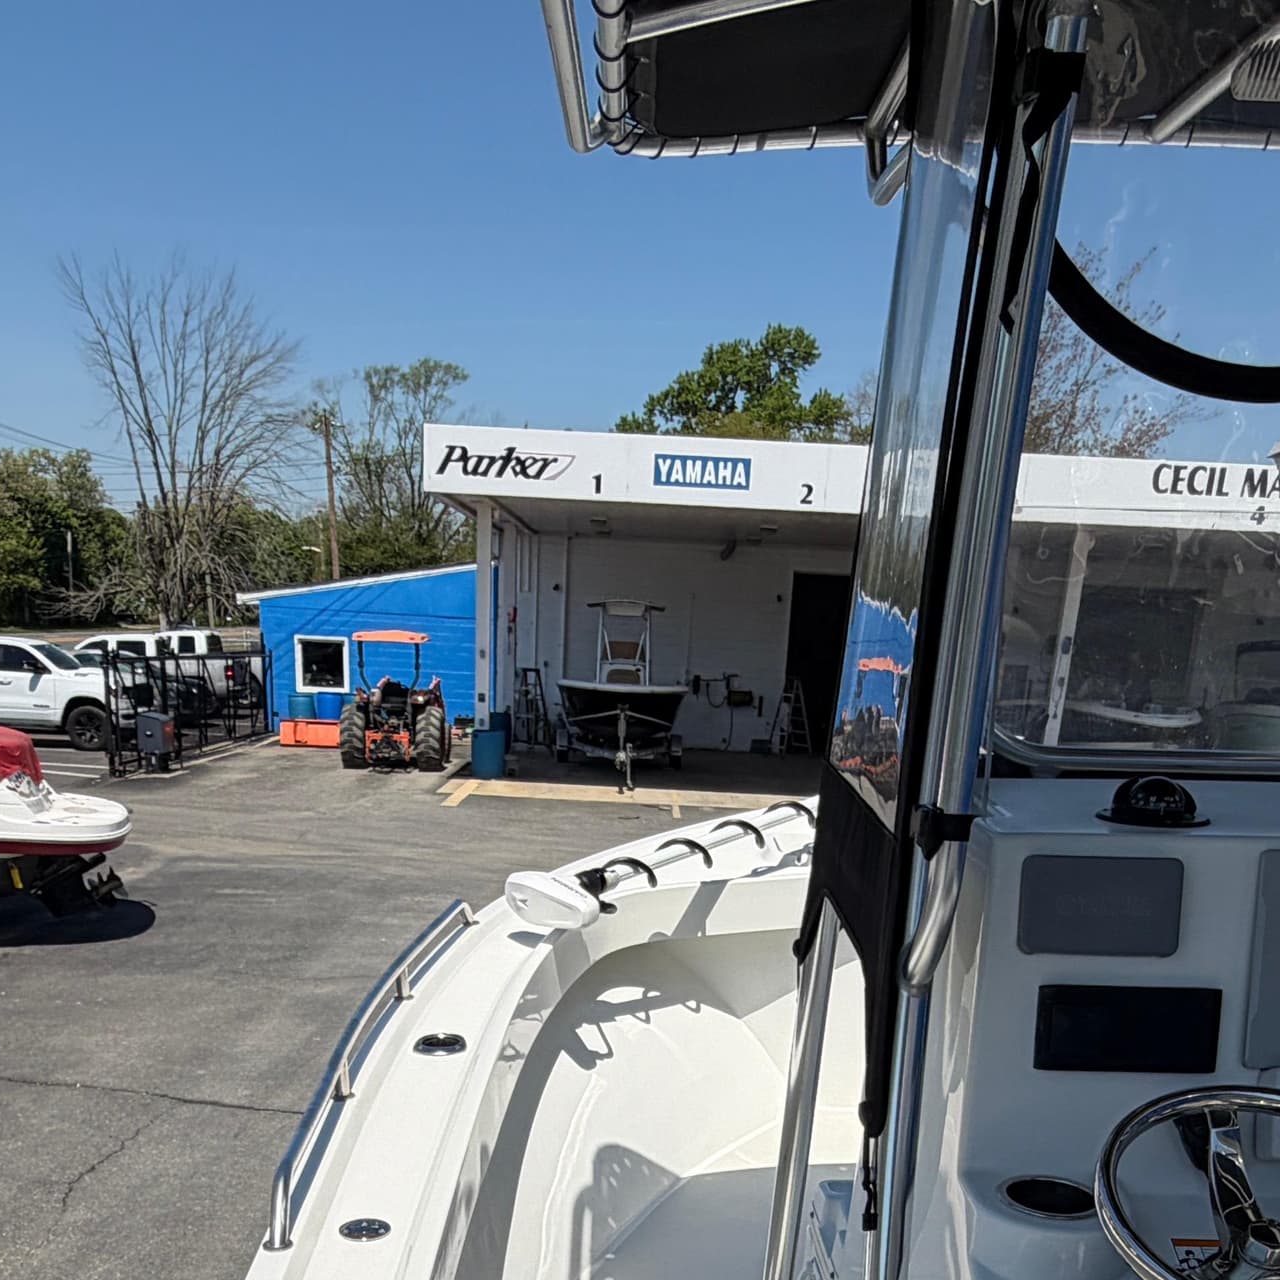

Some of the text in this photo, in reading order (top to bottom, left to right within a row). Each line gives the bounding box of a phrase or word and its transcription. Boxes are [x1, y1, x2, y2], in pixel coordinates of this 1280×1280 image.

[435, 445, 558, 481] Parker
[657, 458, 747, 486] YAMAHA
[591, 473, 602, 494] 1
[1152, 463, 1230, 497] CECIL
[799, 483, 814, 504] 2
[1249, 505, 1266, 525] 4
